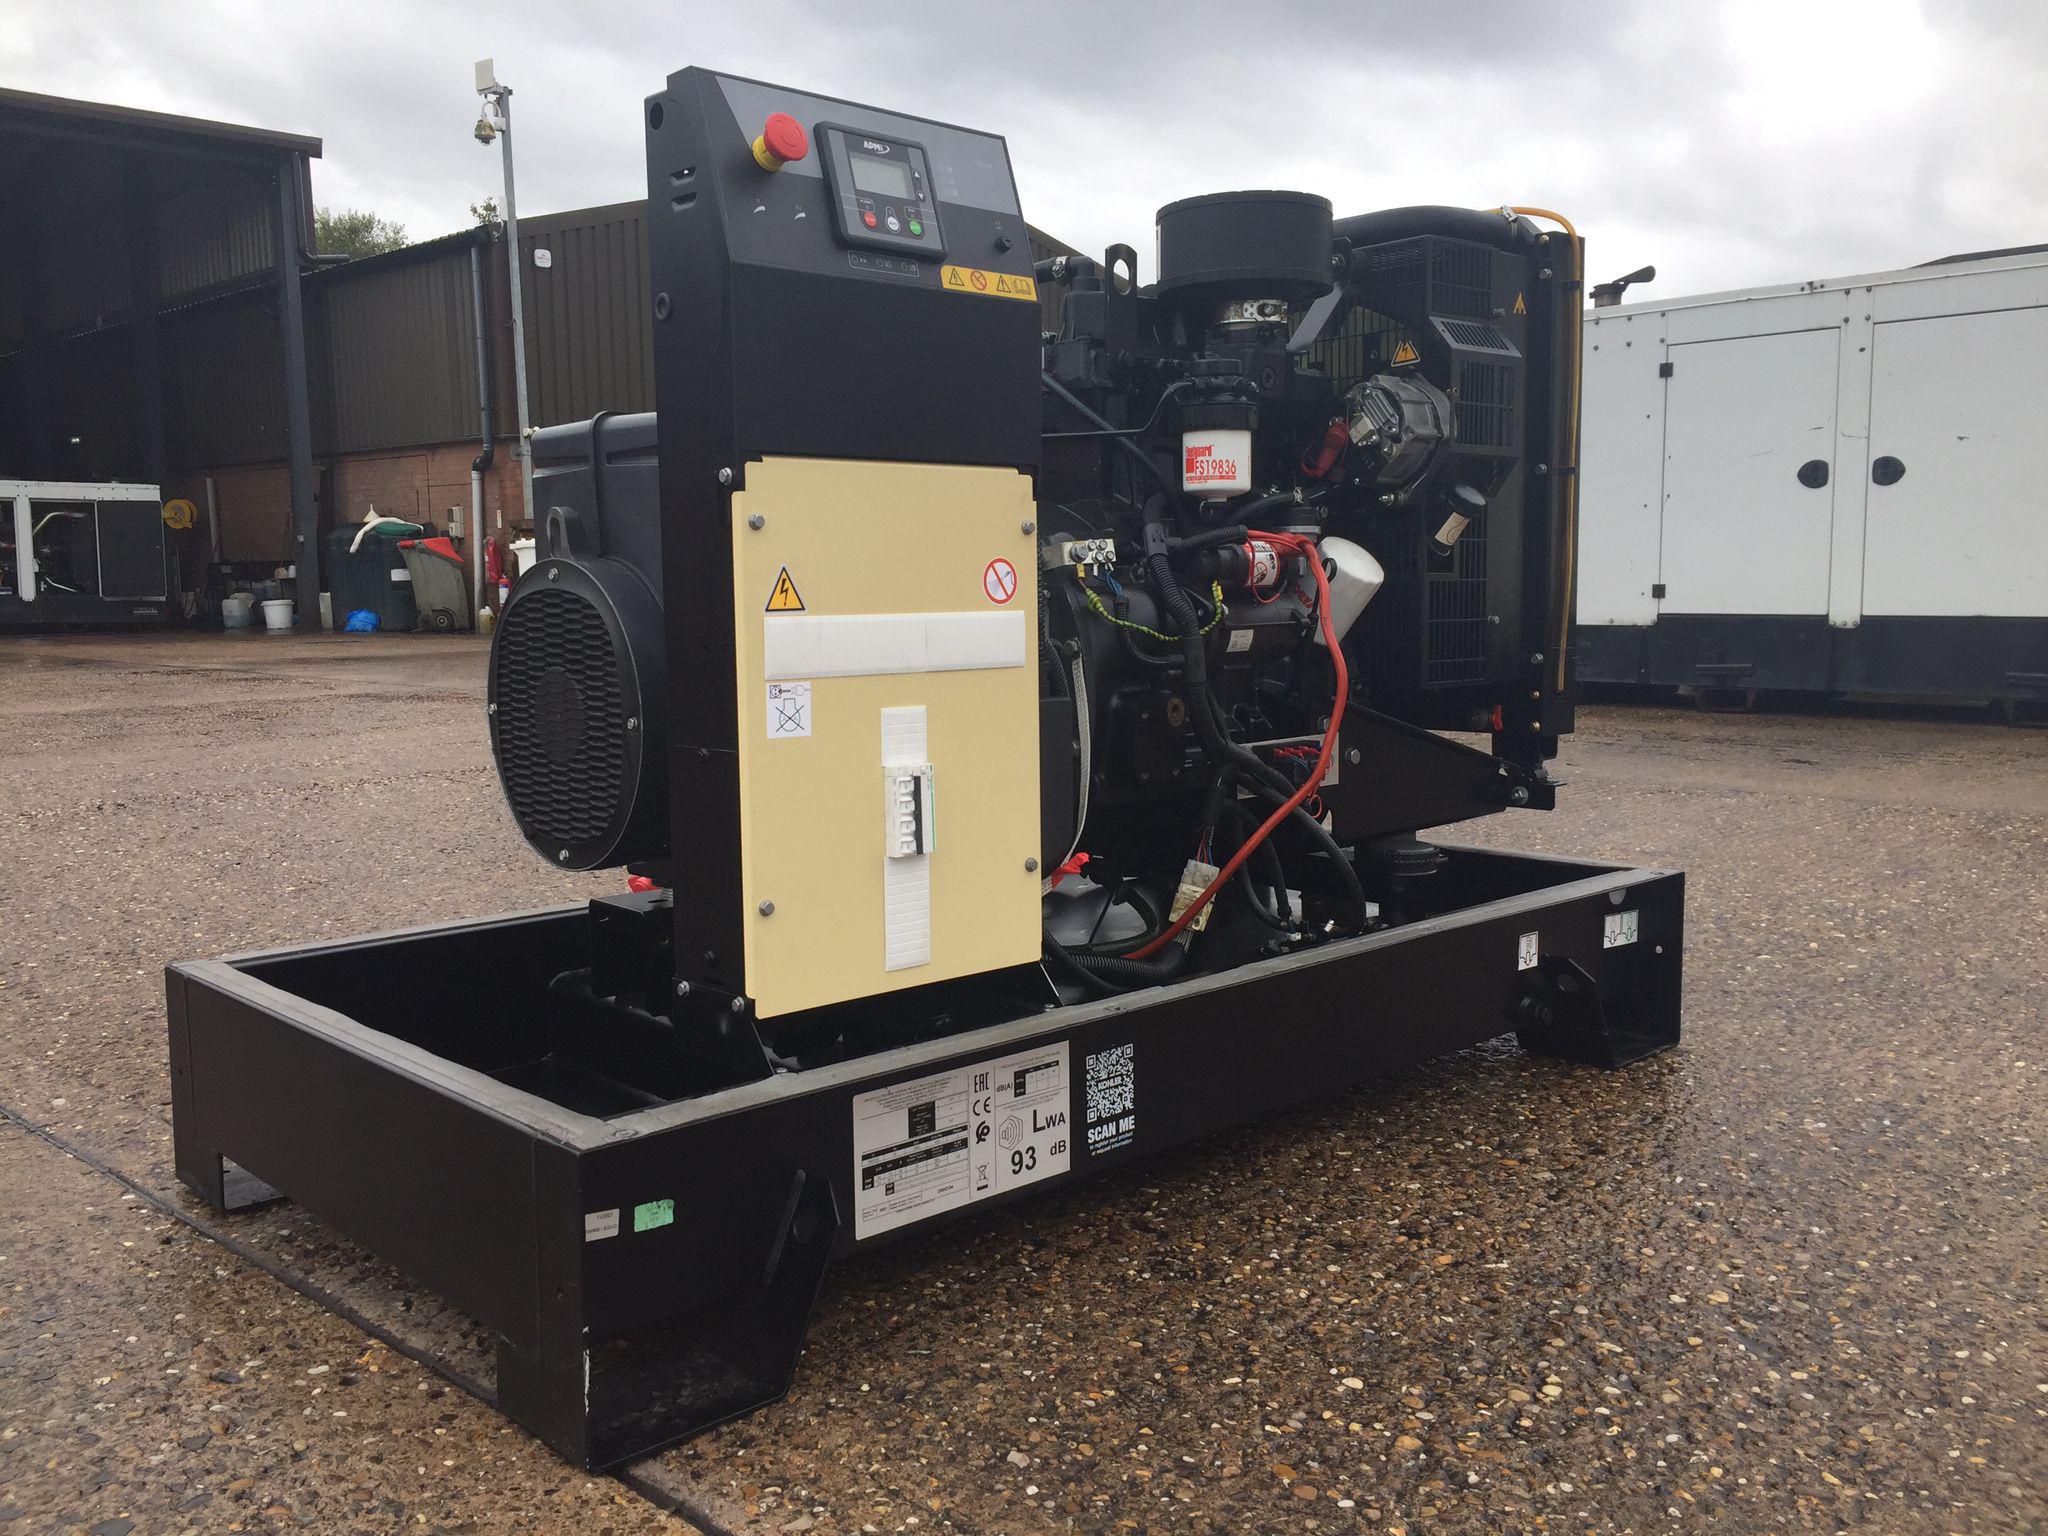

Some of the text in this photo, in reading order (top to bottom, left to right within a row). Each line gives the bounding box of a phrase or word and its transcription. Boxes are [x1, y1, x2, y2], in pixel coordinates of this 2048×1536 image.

[1195, 459, 1236, 475] FS19836
[996, 1082, 1014, 1093] dB(A)
[1098, 1077, 1121, 1090] KOHLER
[973, 1096, 991, 1116] CE
[1088, 1115, 1135, 1143] SCAN ME
[1050, 1140, 1067, 1156] dB
[1011, 1145, 1037, 1175] 93
